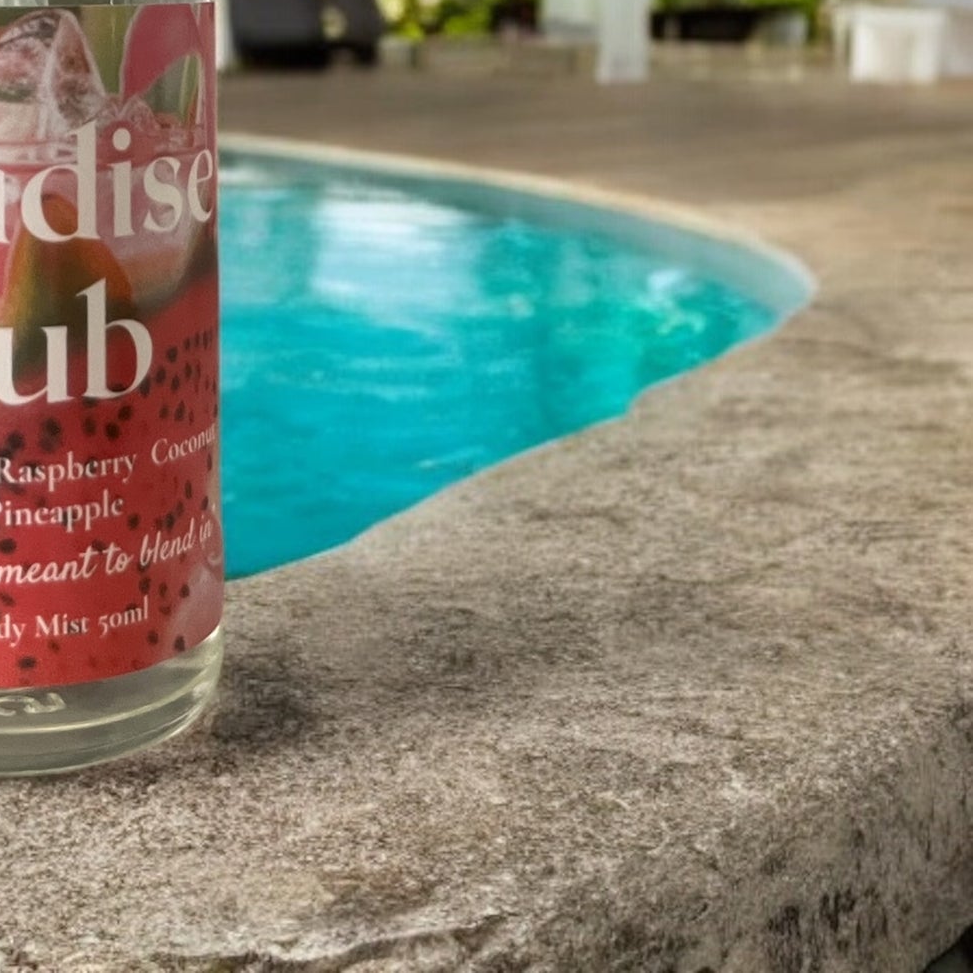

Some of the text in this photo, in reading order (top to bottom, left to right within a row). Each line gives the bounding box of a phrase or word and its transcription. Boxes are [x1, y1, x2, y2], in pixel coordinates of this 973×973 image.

[101, 542, 134, 575] to
[139, 517, 197, 566] blend
[35, 613, 89, 638] Mist
[98, 594, 149, 638] 50ml
